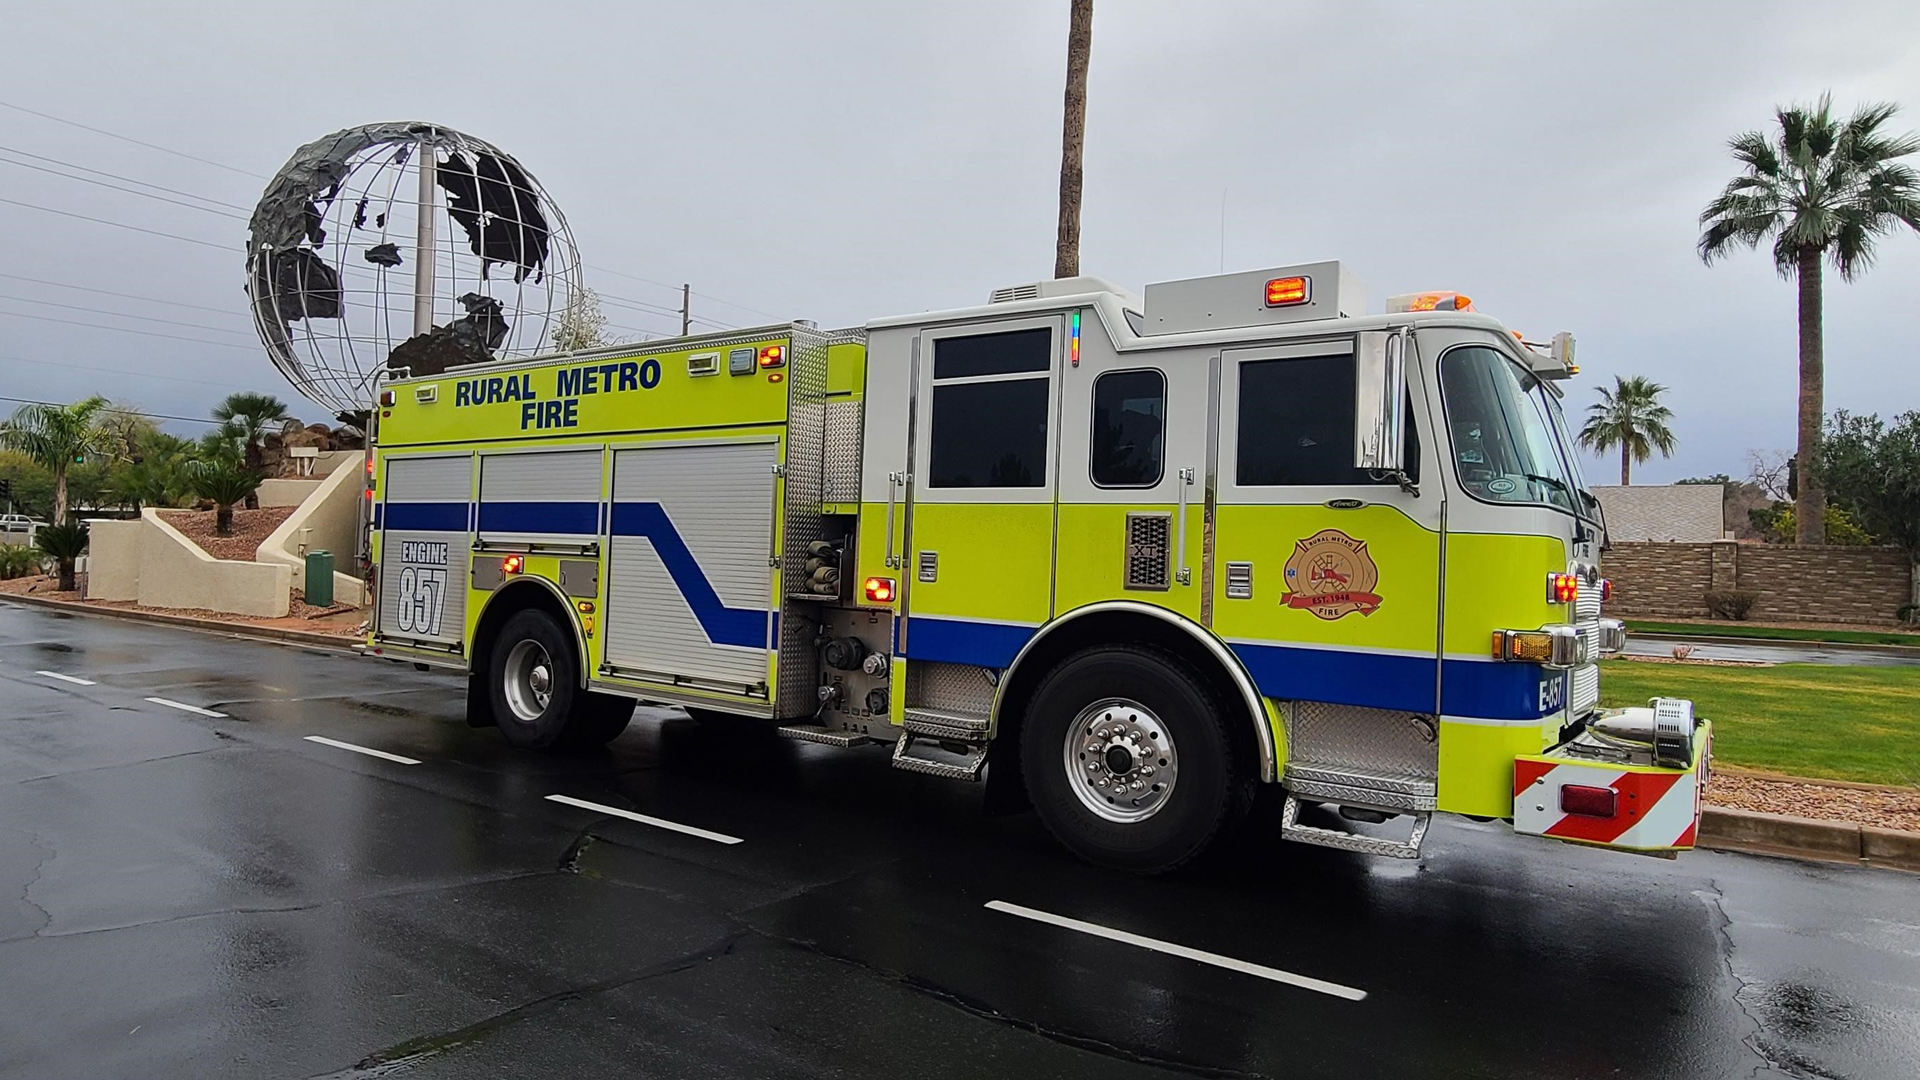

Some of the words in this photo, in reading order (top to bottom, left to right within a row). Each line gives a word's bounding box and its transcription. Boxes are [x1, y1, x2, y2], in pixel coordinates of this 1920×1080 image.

[455, 373, 537, 407] RURAL
[556, 359, 661, 398] METRO
[520, 399, 579, 430] FIRE
[401, 541, 448, 566] ENGINE
[1133, 545, 1158, 556] XT
[1308, 536, 1329, 547] RURAL
[1331, 536, 1354, 548] METRO
[397, 566, 448, 636] 857
[1312, 596, 1330, 605] EST.
[1331, 593, 1350, 603] 1948
[1318, 607, 1340, 616] FIRE
[1539, 676, 1562, 711] E-857
